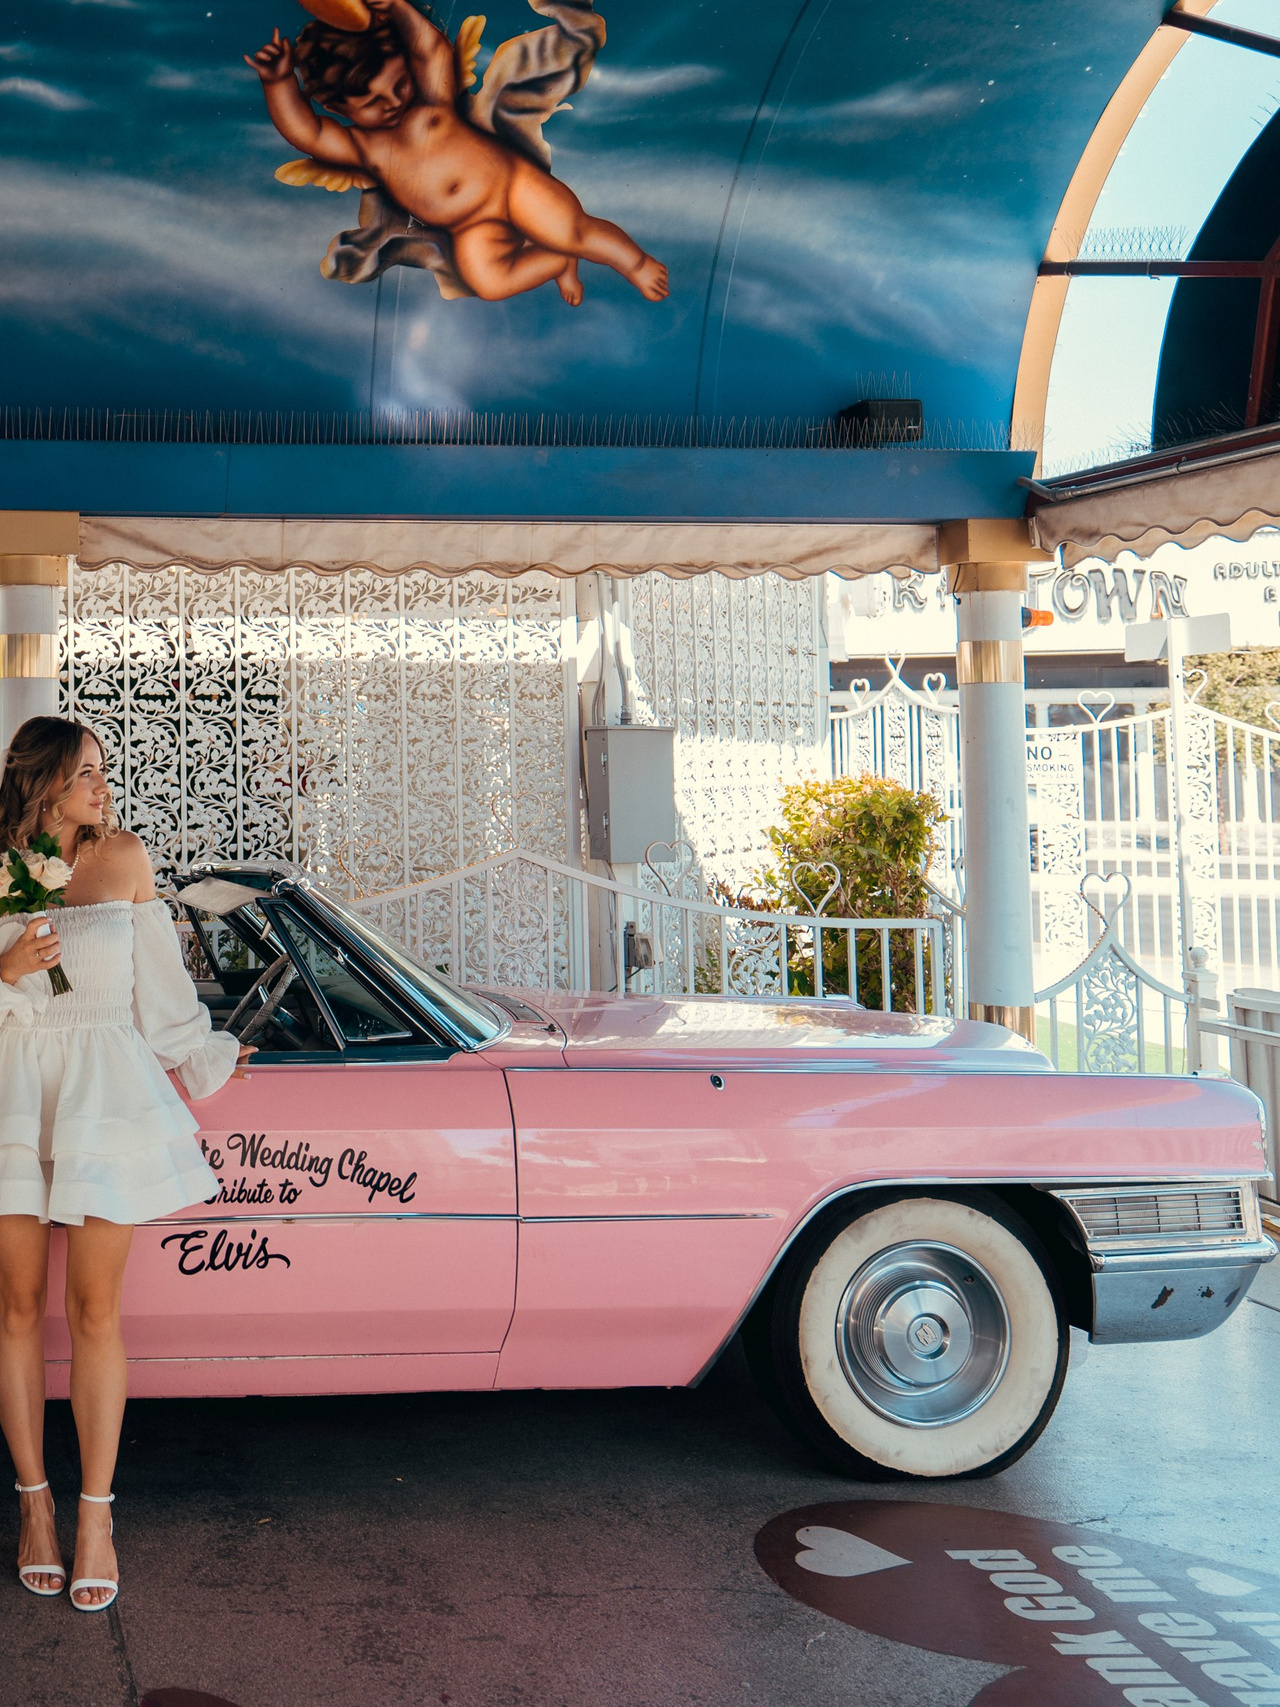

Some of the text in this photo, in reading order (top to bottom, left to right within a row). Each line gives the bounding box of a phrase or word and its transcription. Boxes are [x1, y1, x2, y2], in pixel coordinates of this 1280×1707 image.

[1027, 746, 1052, 760] NO
[1027, 763, 1074, 772] SMOKING
[227, 1133, 333, 1187] Wedding
[337, 1148, 418, 1203] Chapel
[278, 1178, 303, 1204] to
[160, 1228, 291, 1275] Elvis
[944, 1549, 1096, 1621] God
[1051, 1545, 1179, 1602] me
[1050, 1629, 1211, 1707] ank
